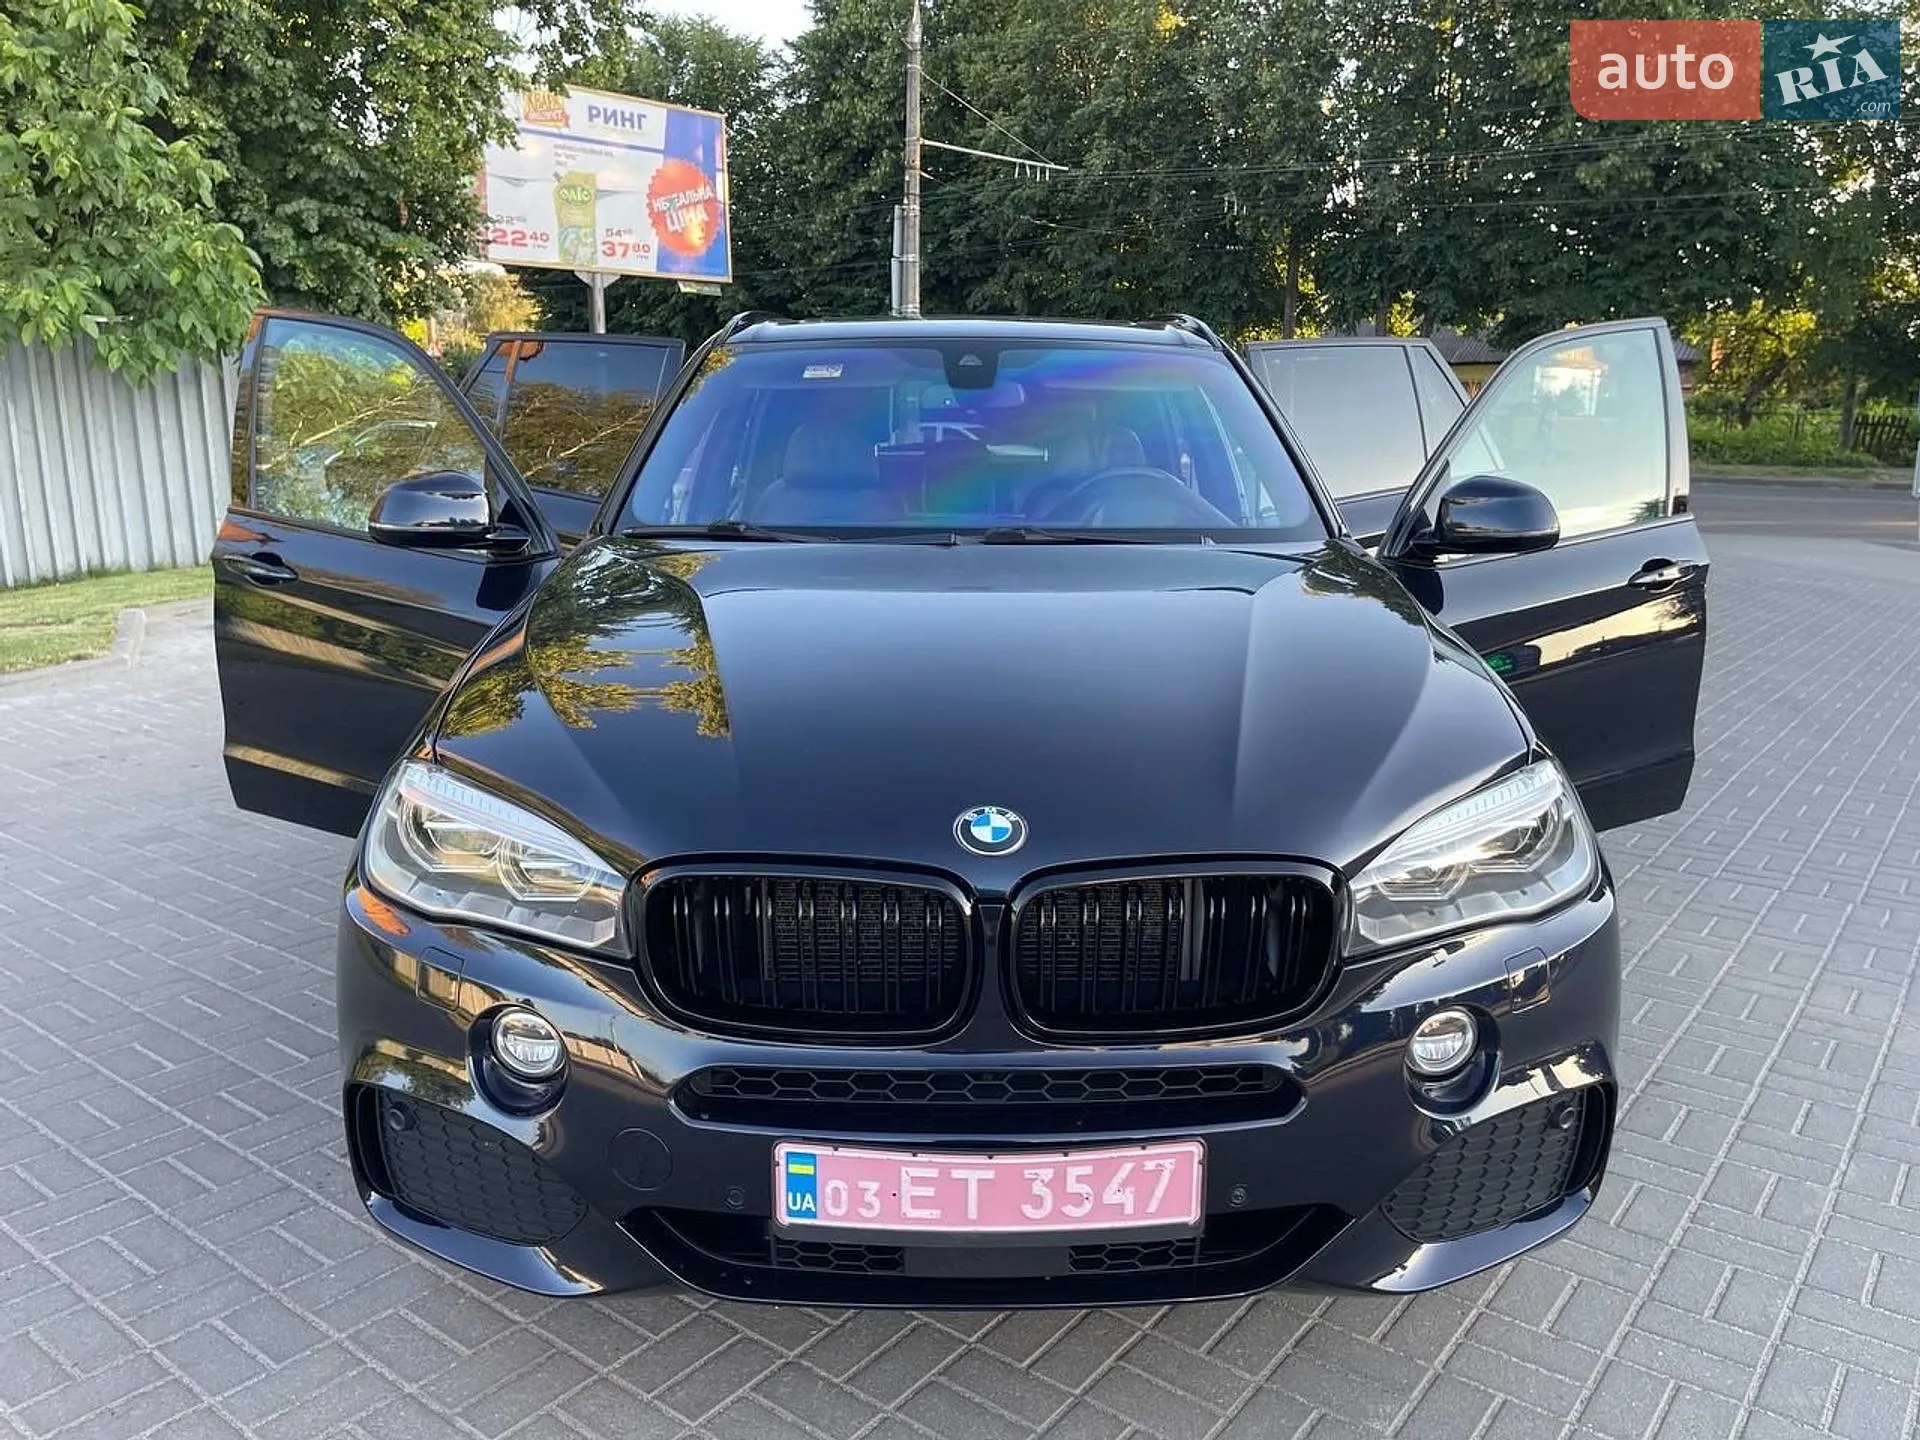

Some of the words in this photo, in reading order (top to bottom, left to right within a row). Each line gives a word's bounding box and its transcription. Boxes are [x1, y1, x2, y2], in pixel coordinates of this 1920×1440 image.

[587, 104, 648, 130] РИНГ
[965, 807, 1019, 821] BMW
[824, 1180, 881, 1218] 03
[900, 1165, 996, 1220] ET
[1021, 1158, 1177, 1220] 3547
[788, 1192, 816, 1212] UA
